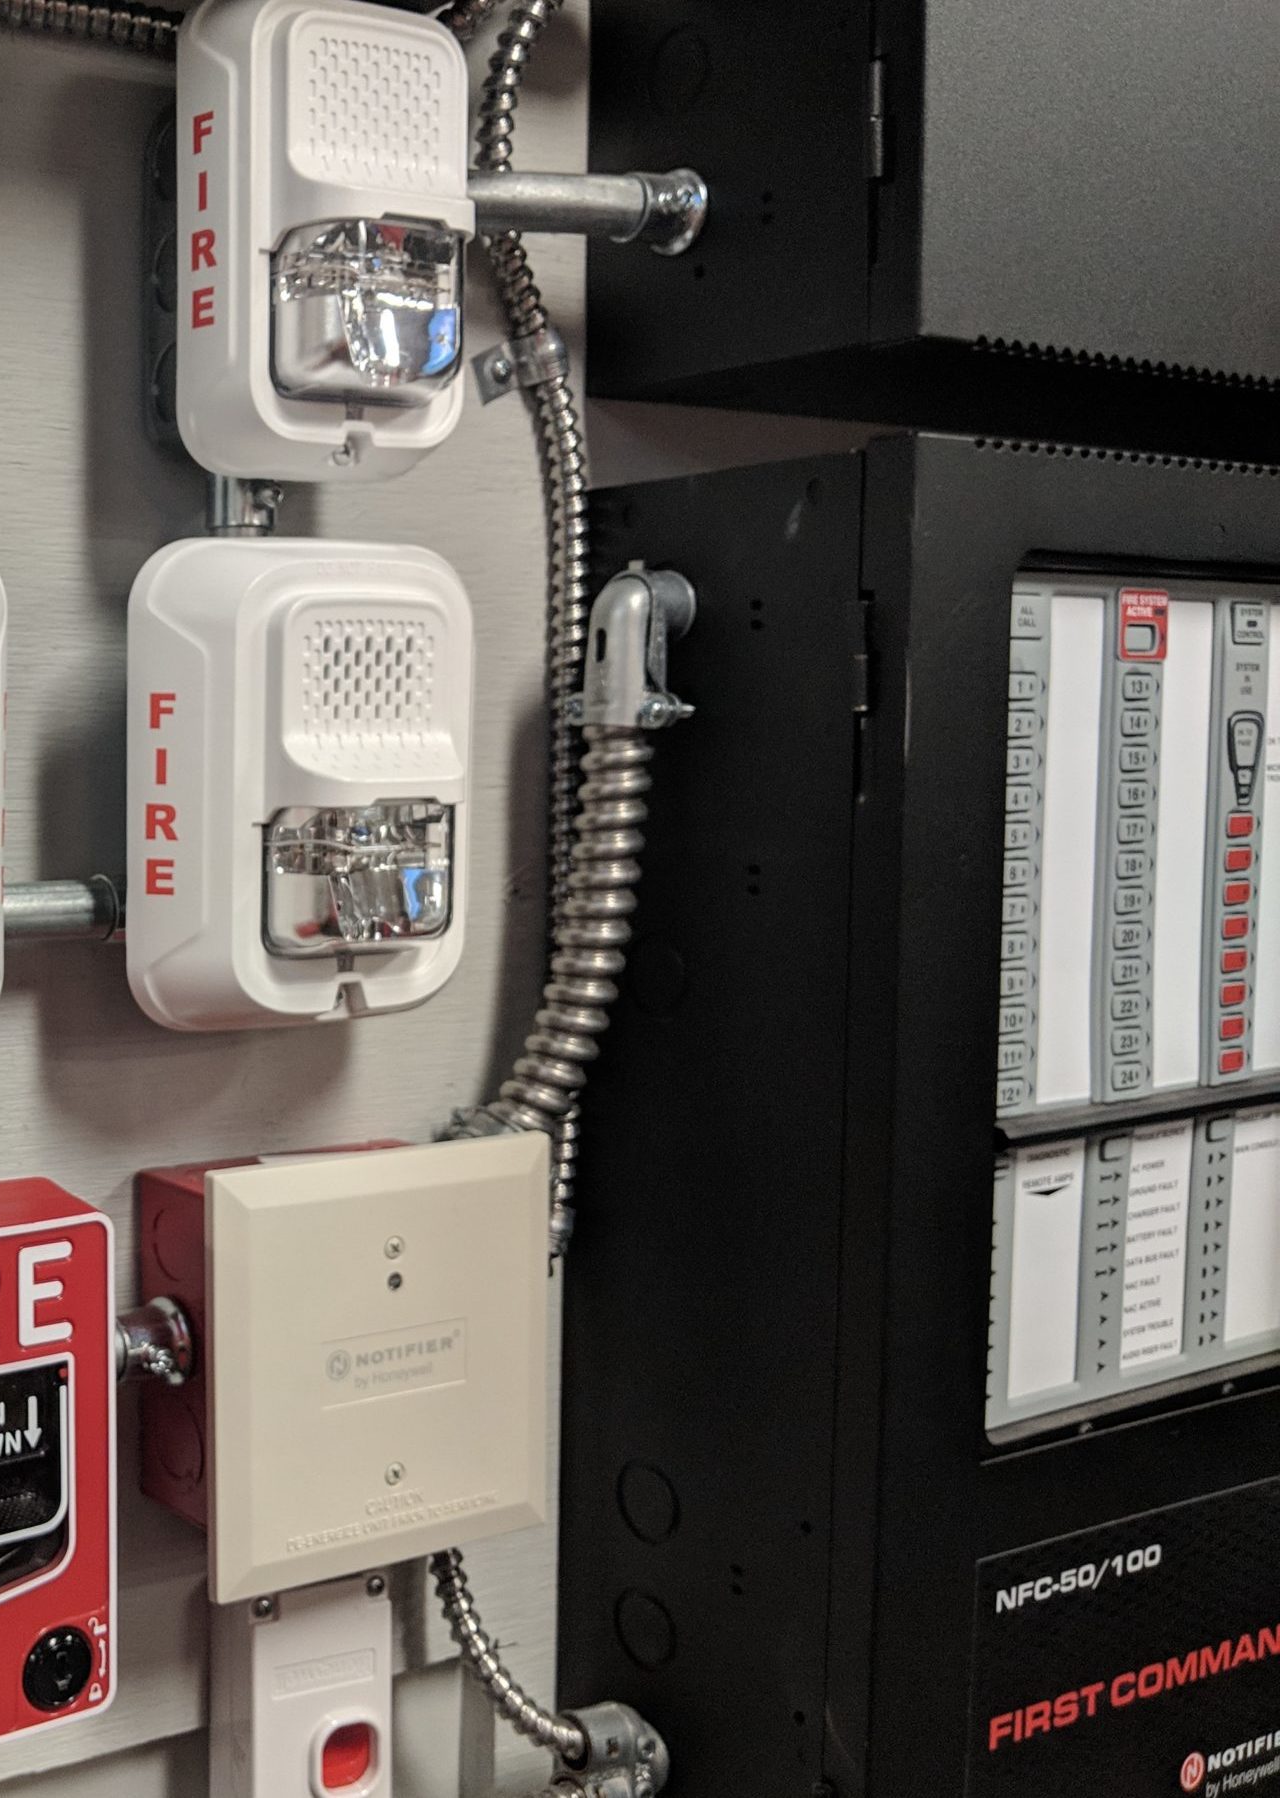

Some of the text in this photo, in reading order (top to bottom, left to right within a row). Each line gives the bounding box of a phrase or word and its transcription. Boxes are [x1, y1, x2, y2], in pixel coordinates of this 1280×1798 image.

[191, 111, 217, 329] FIRE
[1020, 605, 1034, 616] ALL
[1017, 617, 1037, 628] CALL
[1017, 681, 1023, 693] 1
[1131, 680, 1143, 693] 13
[1014, 719, 1022, 732] 2
[1130, 716, 1142, 729] 14
[1013, 755, 1020, 769] 3
[1128, 752, 1140, 765] 15
[144, 693, 178, 896] FIRE
[1012, 793, 1019, 805] 4
[1127, 788, 1139, 800] 16
[1126, 823, 1138, 836] 17
[1010, 830, 1017, 843] 5
[1124, 859, 1137, 872] 18
[1123, 895, 1135, 907] 19
[1122, 930, 1134, 942] 20
[1122, 966, 1133, 978] 21
[1007, 977, 1014, 991] 9
[1121, 1001, 1133, 1013] 22
[1004, 1013, 1017, 1027] 10
[1121, 1036, 1133, 1048] 23
[1003, 1051, 1016, 1065] 11
[1121, 1072, 1133, 1084] 24
[1001, 1088, 1014, 1102] 12
[355, 1336, 454, 1368] NOTIFIER
[995, 1544, 1163, 1613] NFC-50/100
[989, 1682, 1106, 1751] FIRST
[1206, 1781, 1220, 1798] by
